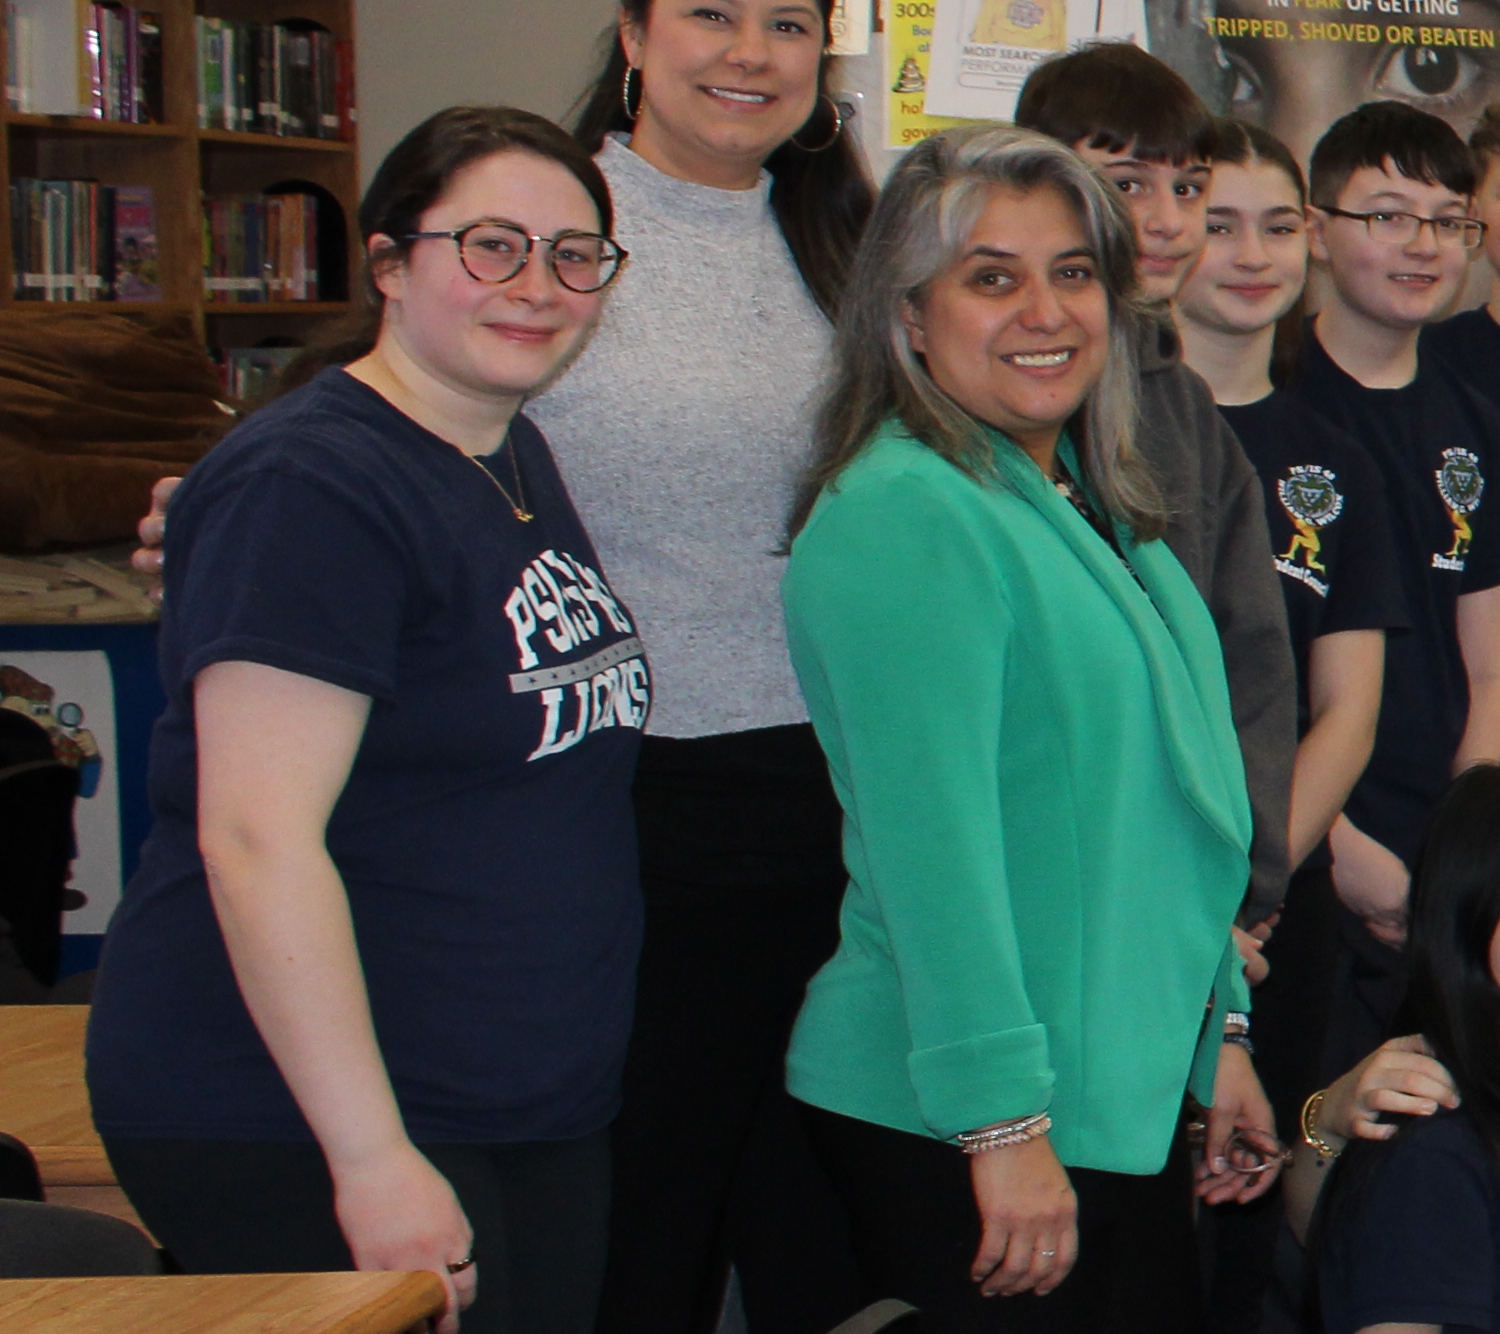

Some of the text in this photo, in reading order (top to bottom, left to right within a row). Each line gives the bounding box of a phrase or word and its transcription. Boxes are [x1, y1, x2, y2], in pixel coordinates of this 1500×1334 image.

[1206, 16, 1294, 42] TRIPPED,
[1299, 20, 1380, 44] SHOVED
[1385, 25, 1415, 45] OR
[1420, 27, 1495, 49] BEATEN
[526, 657, 650, 763] LIONS
